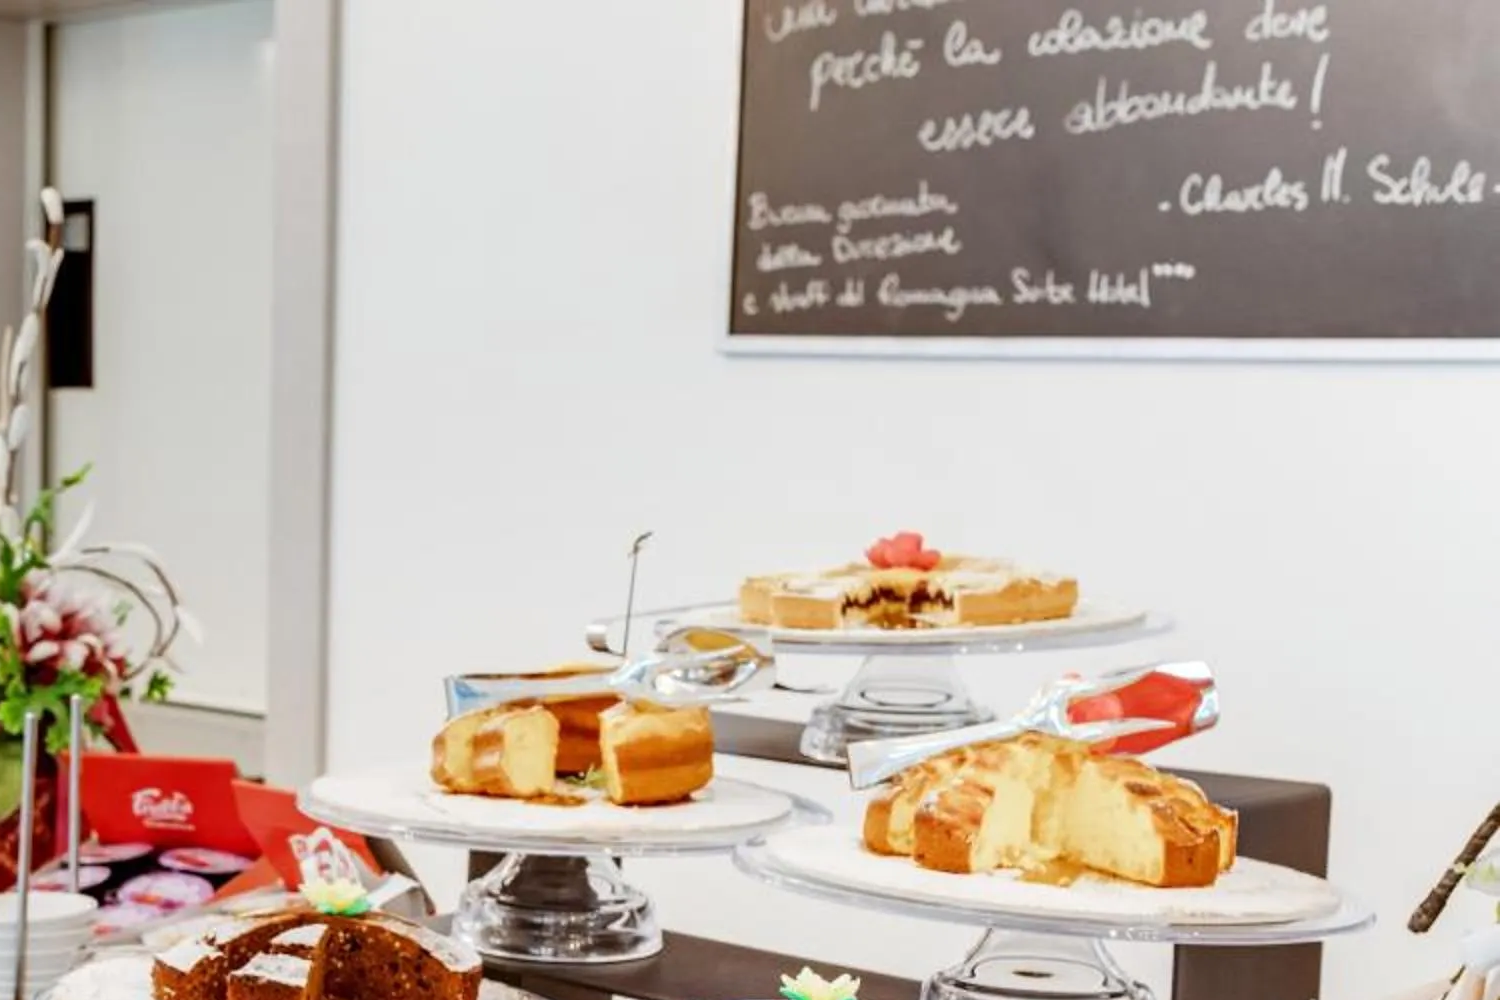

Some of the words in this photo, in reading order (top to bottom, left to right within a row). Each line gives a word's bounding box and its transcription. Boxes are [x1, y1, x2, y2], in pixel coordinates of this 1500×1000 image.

[943, 20, 1001, 66] la
[1028, 7, 1213, 56] colazione
[1245, 0, 1329, 43] deve
[917, 107, 1036, 150] essere
